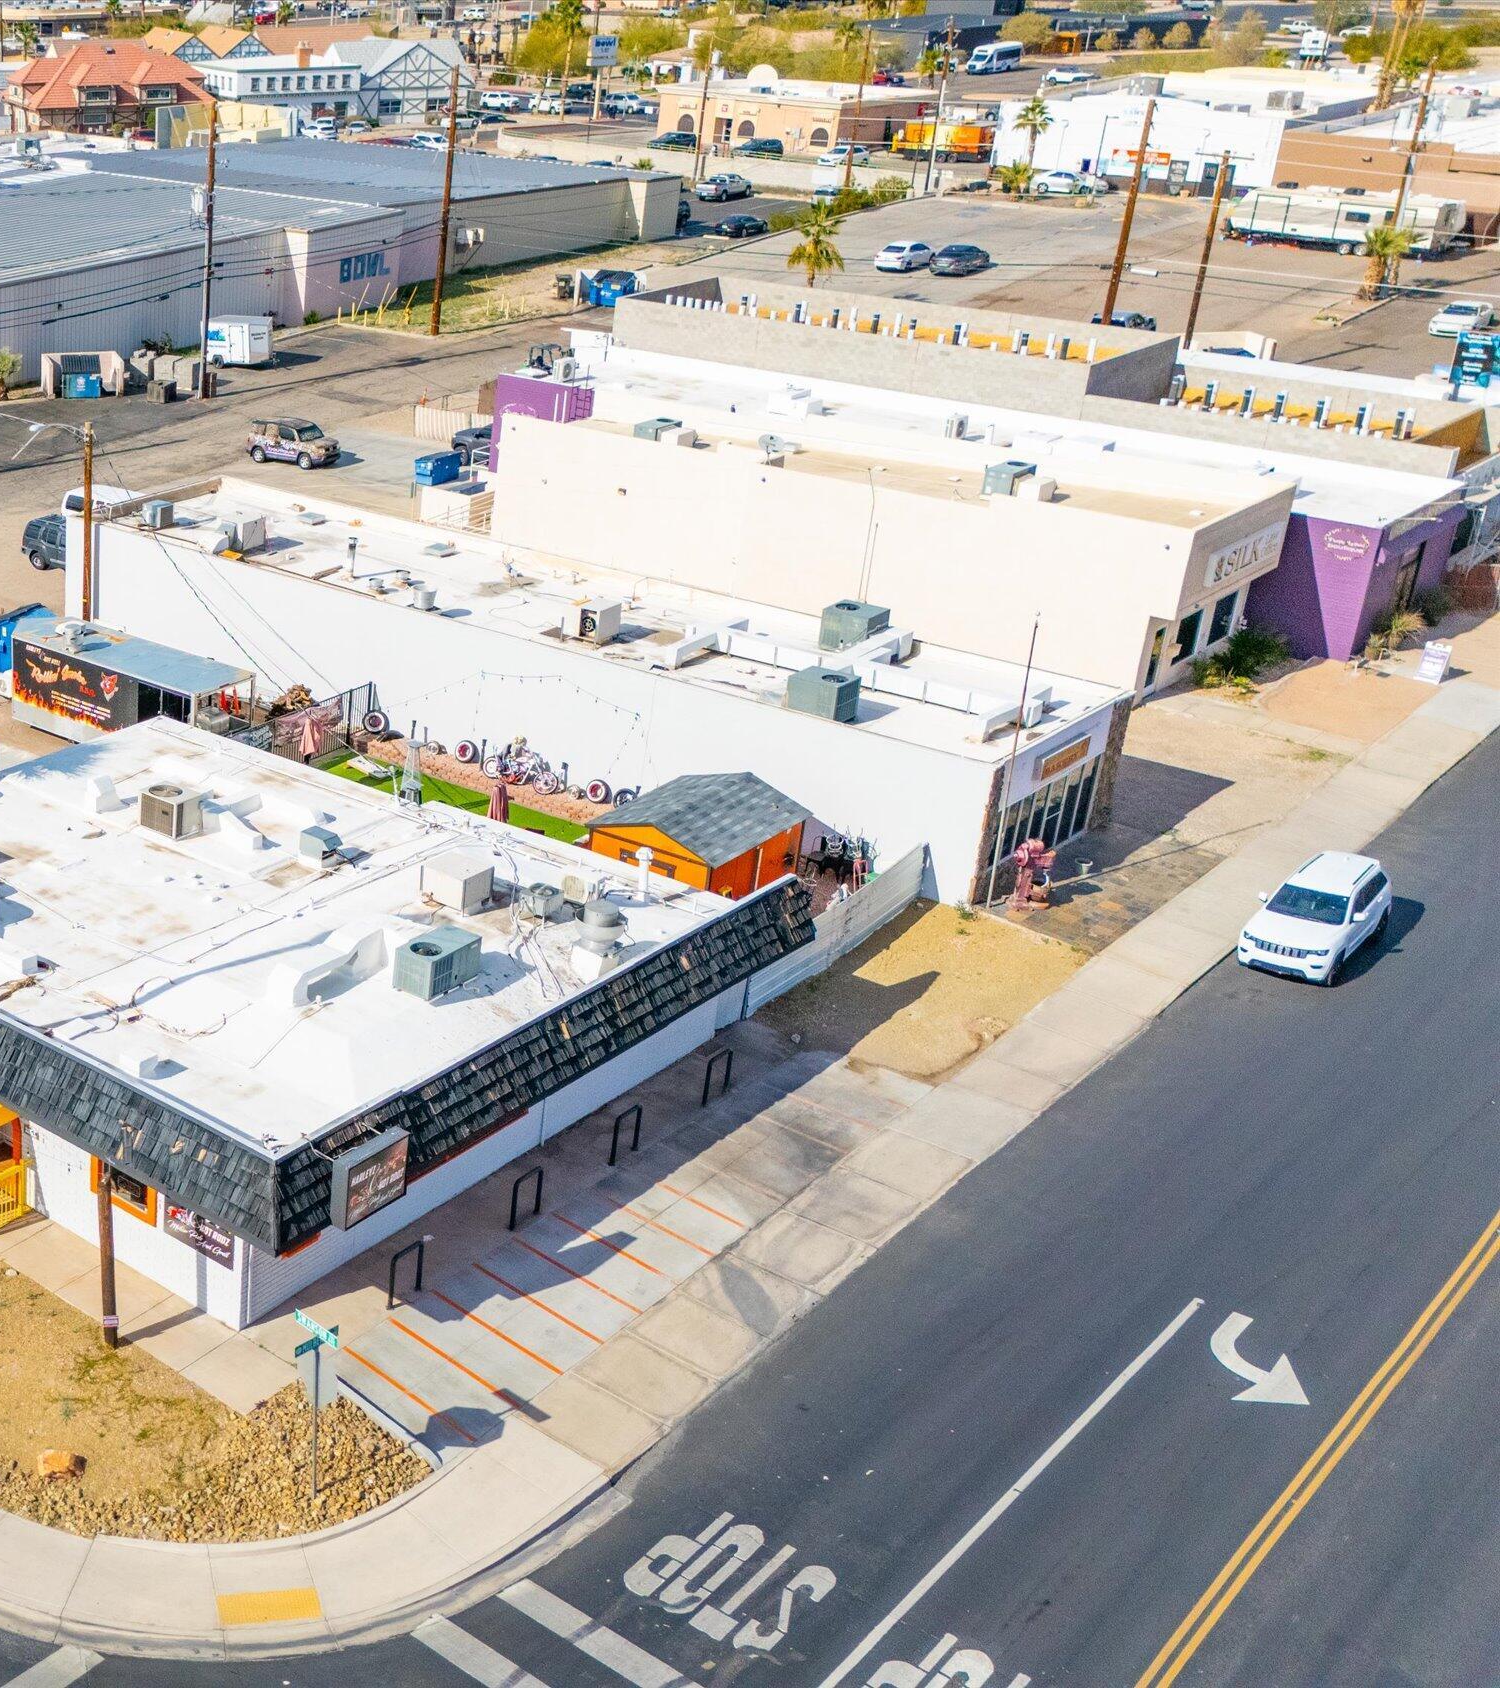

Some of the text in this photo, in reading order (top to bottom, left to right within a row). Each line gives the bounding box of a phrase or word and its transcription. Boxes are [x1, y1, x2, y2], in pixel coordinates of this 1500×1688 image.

[340, 252, 391, 284] BOWL
[1224, 535, 1264, 576] SILK
[623, 1511, 837, 1652] STOP
